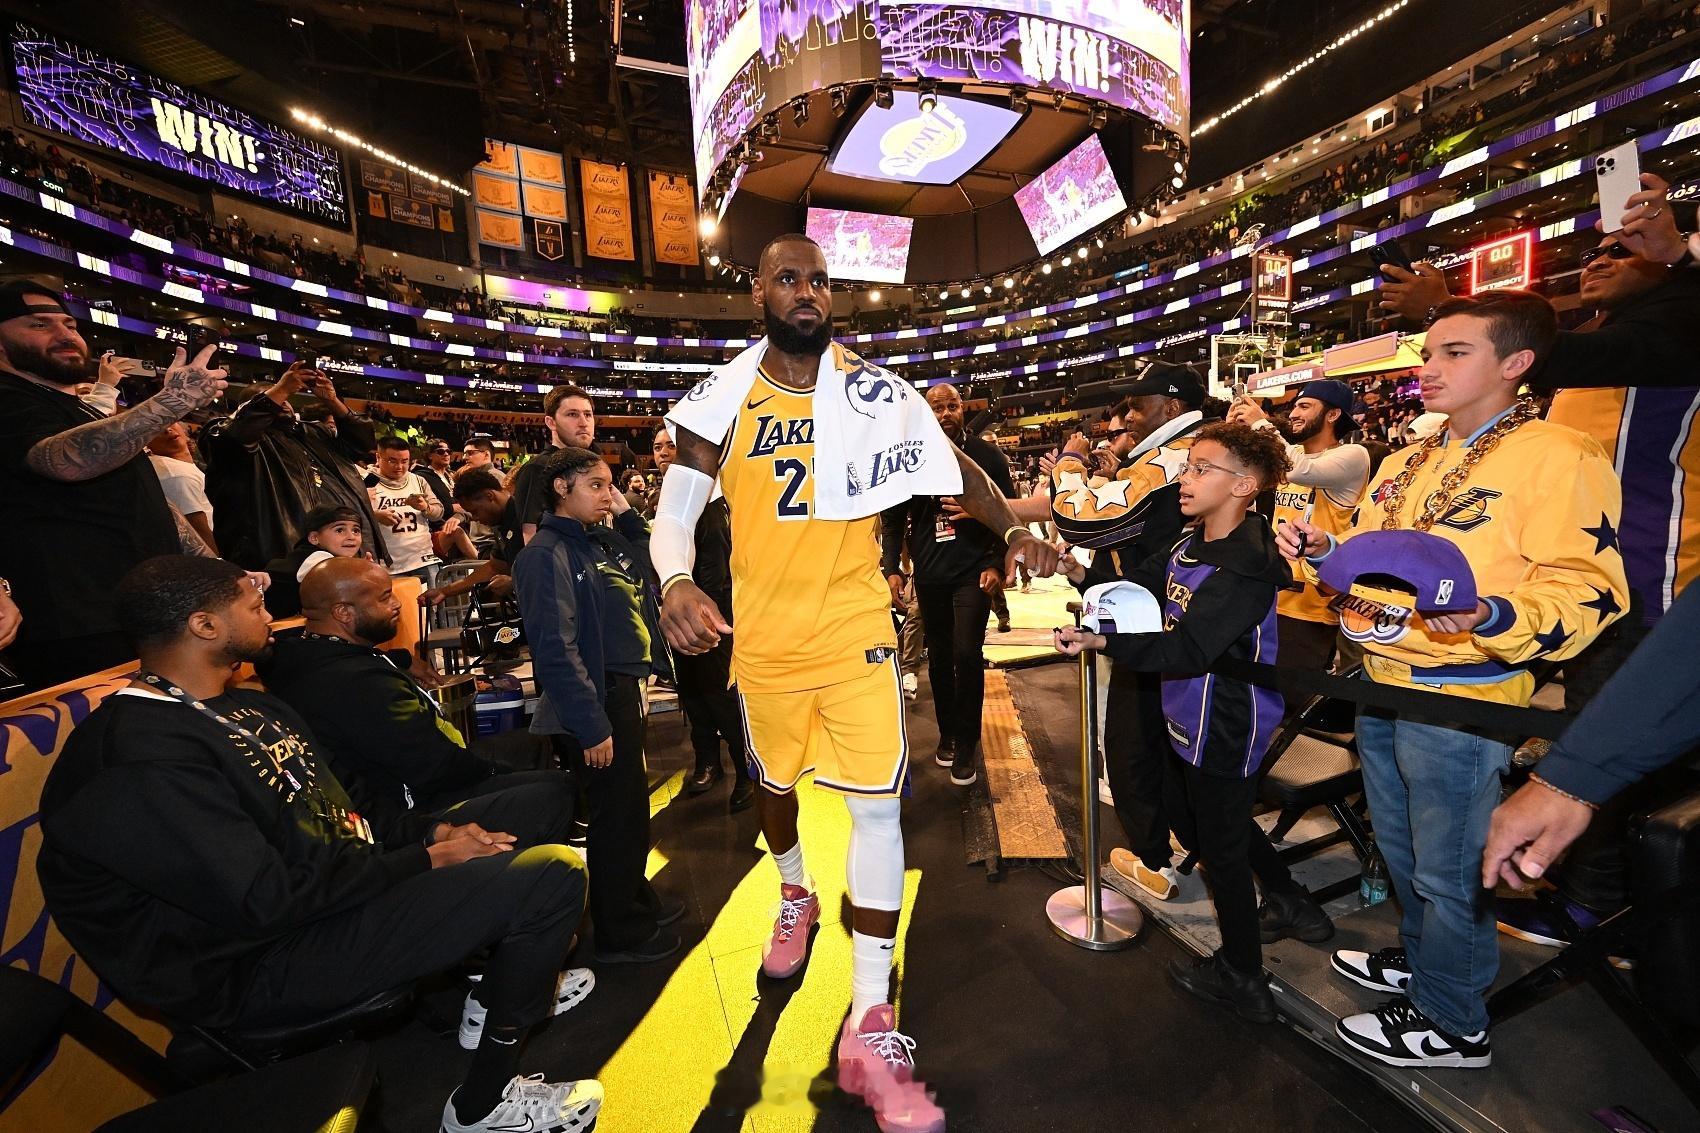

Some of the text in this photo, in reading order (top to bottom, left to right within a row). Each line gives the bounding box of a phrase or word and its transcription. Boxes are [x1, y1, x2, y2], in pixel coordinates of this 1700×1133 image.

[1019, 16, 1110, 94] WIN!
[151, 97, 259, 174] WIN!
[364, 174, 404, 189] CHAMPIONS
[593, 174, 619, 186] LAKERS
[660, 182, 685, 193] LAKERS
[393, 208, 431, 222] CHAMPIONS
[595, 204, 621, 217] LAKERS
[662, 212, 687, 224] LAKERS
[597, 236, 624, 248] LAKERS
[664, 242, 689, 254] LAKERS
[1256, 368, 1313, 389] LAKERS.COM
[774, 458, 815, 516] 2
[378, 496, 407, 510] LAKE
[1275, 490, 1308, 510] KERS
[392, 511, 417, 534] 23
